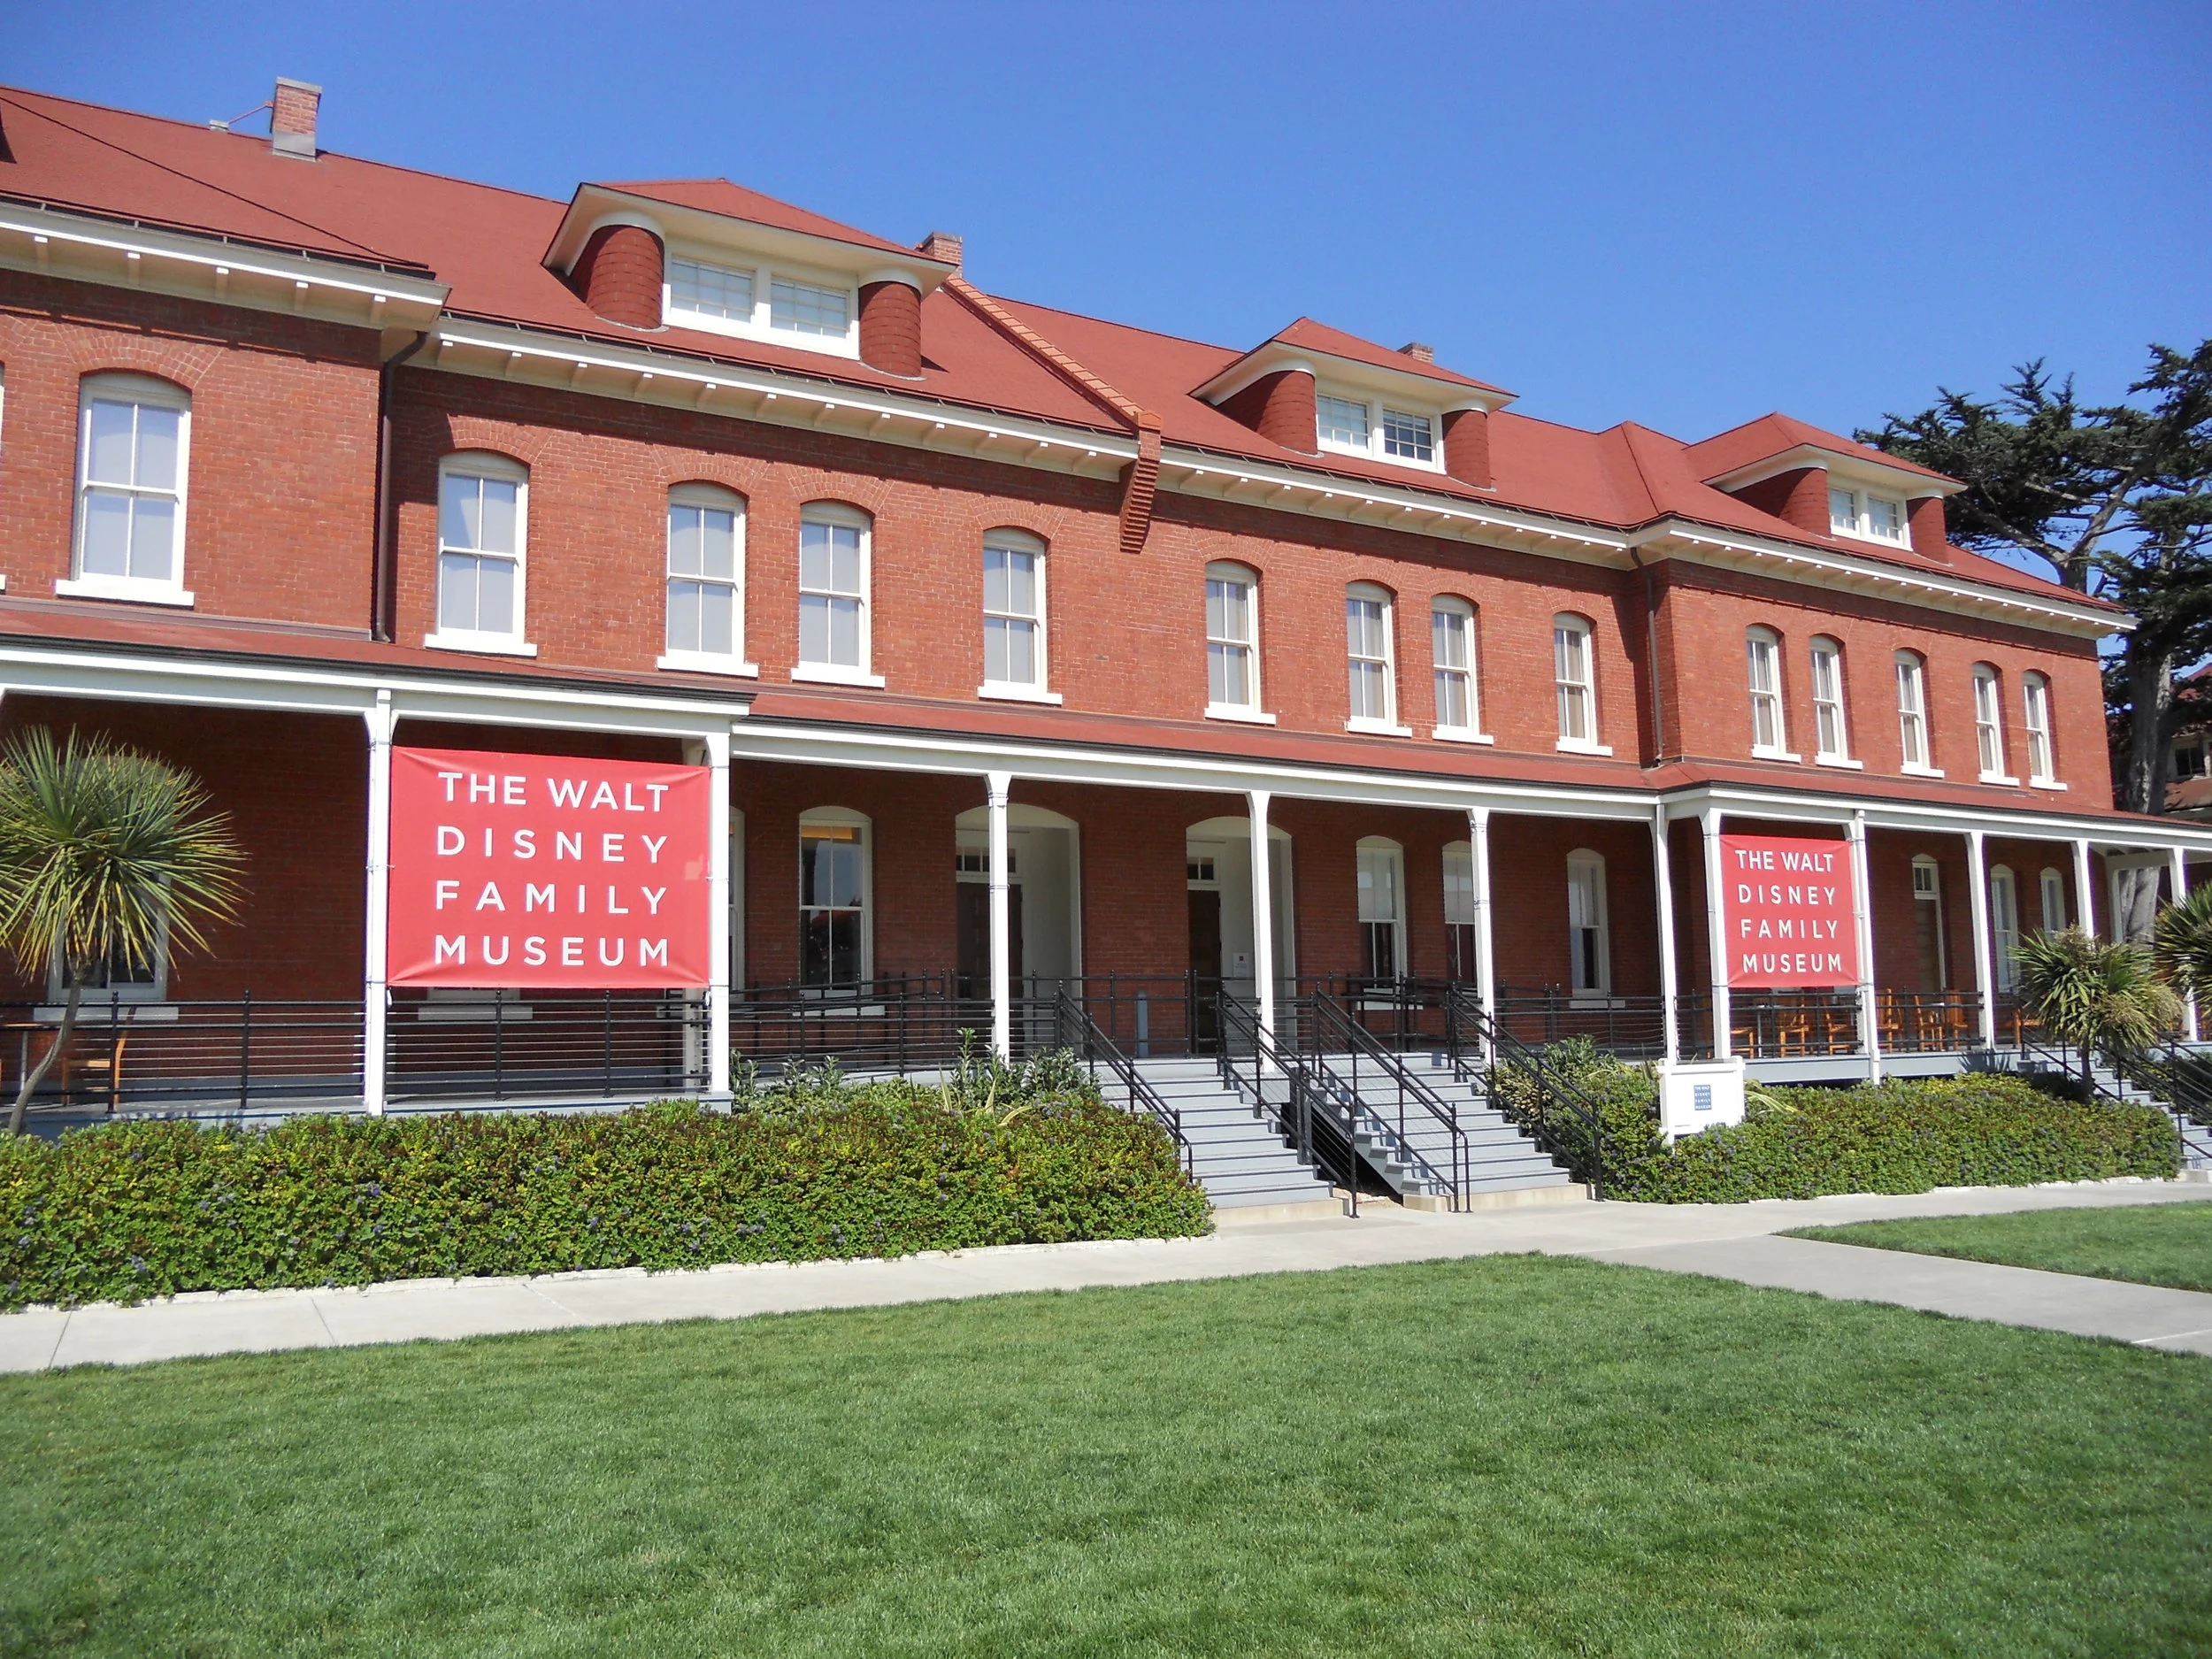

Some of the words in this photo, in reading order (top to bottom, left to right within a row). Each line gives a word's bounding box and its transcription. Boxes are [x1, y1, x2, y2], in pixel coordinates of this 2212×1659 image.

[438, 772, 526, 805] THE
[547, 778, 670, 812] WALT
[436, 825, 669, 864] DISNEY
[1734, 849, 1775, 871] THE
[1780, 851, 1834, 872] WALT
[434, 879, 668, 915] FAMILY
[1738, 884, 1836, 906] DISNEY
[1740, 918, 1839, 939] FAMILY
[434, 934, 669, 967] MUSEUM
[1742, 953, 1842, 973] MUSEUM
